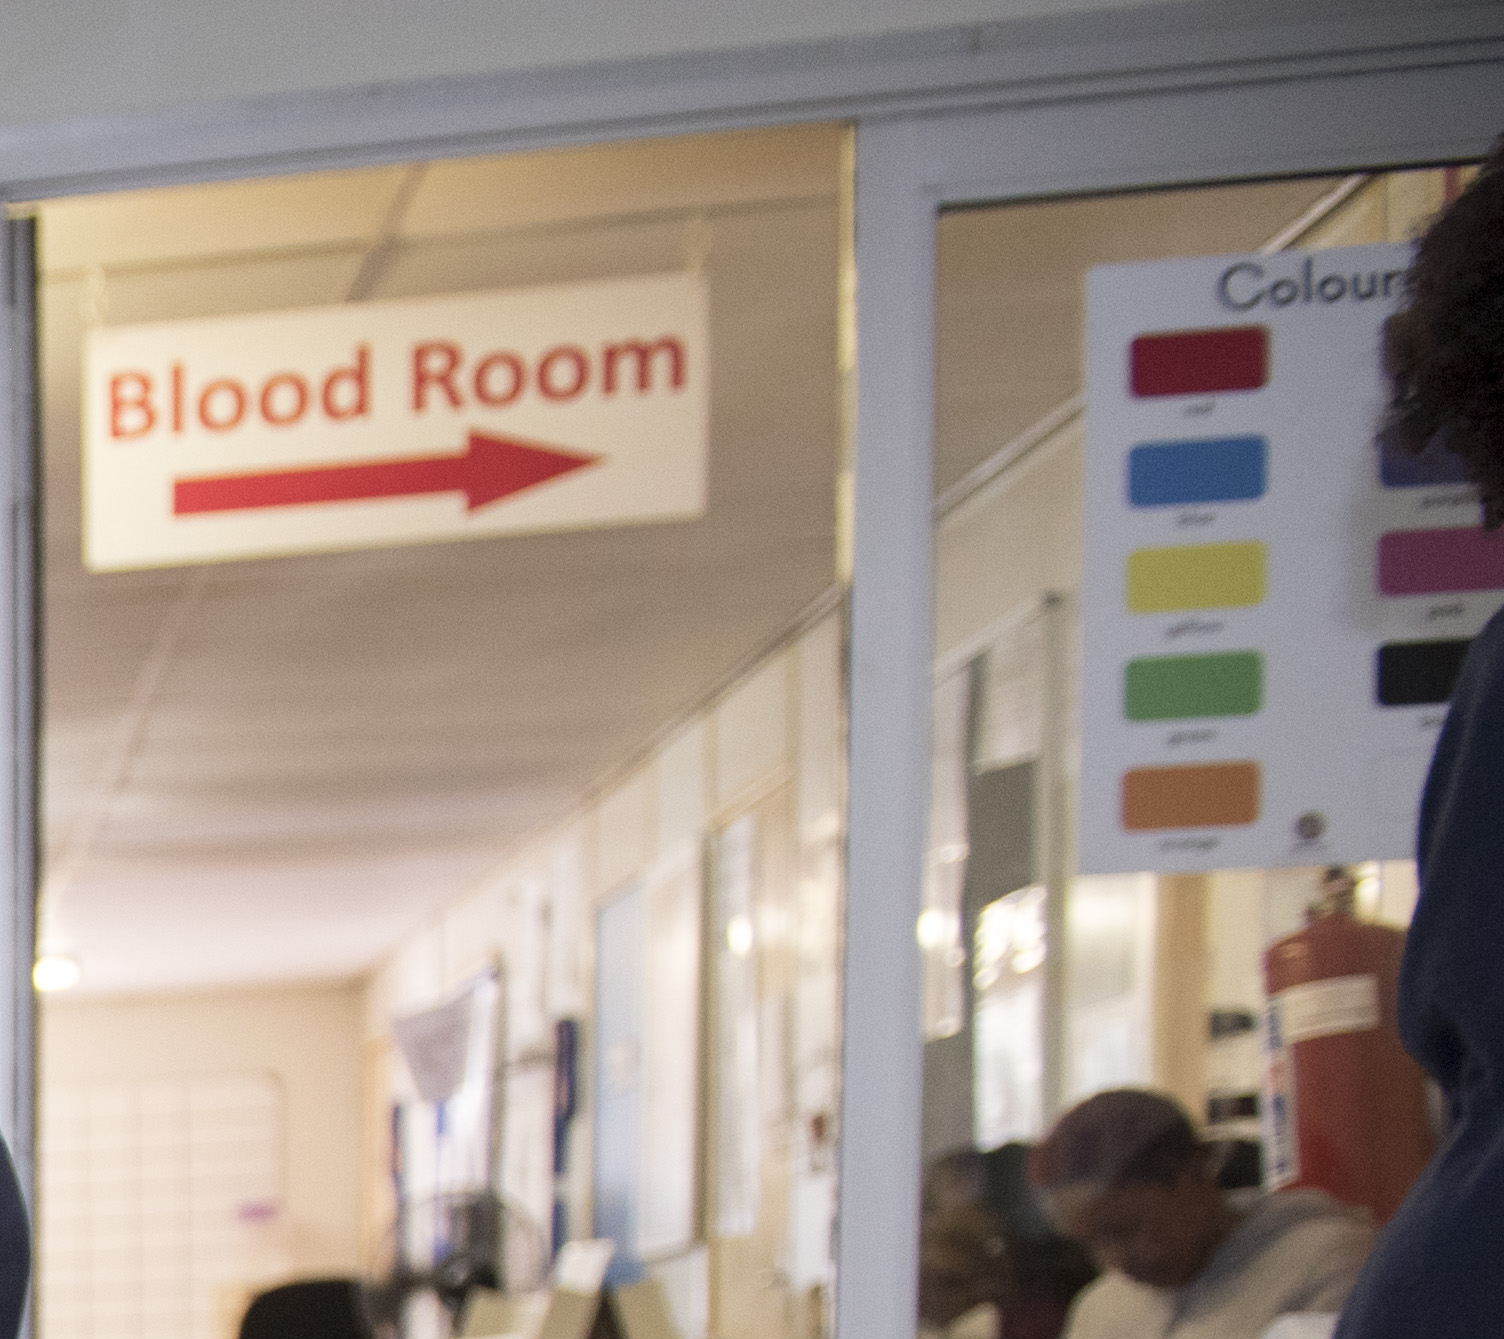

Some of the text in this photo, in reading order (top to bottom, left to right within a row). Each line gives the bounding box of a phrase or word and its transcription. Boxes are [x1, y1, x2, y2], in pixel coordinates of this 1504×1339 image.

[1217, 256, 1408, 313] Colour
[108, 332, 688, 441] Blood Room
